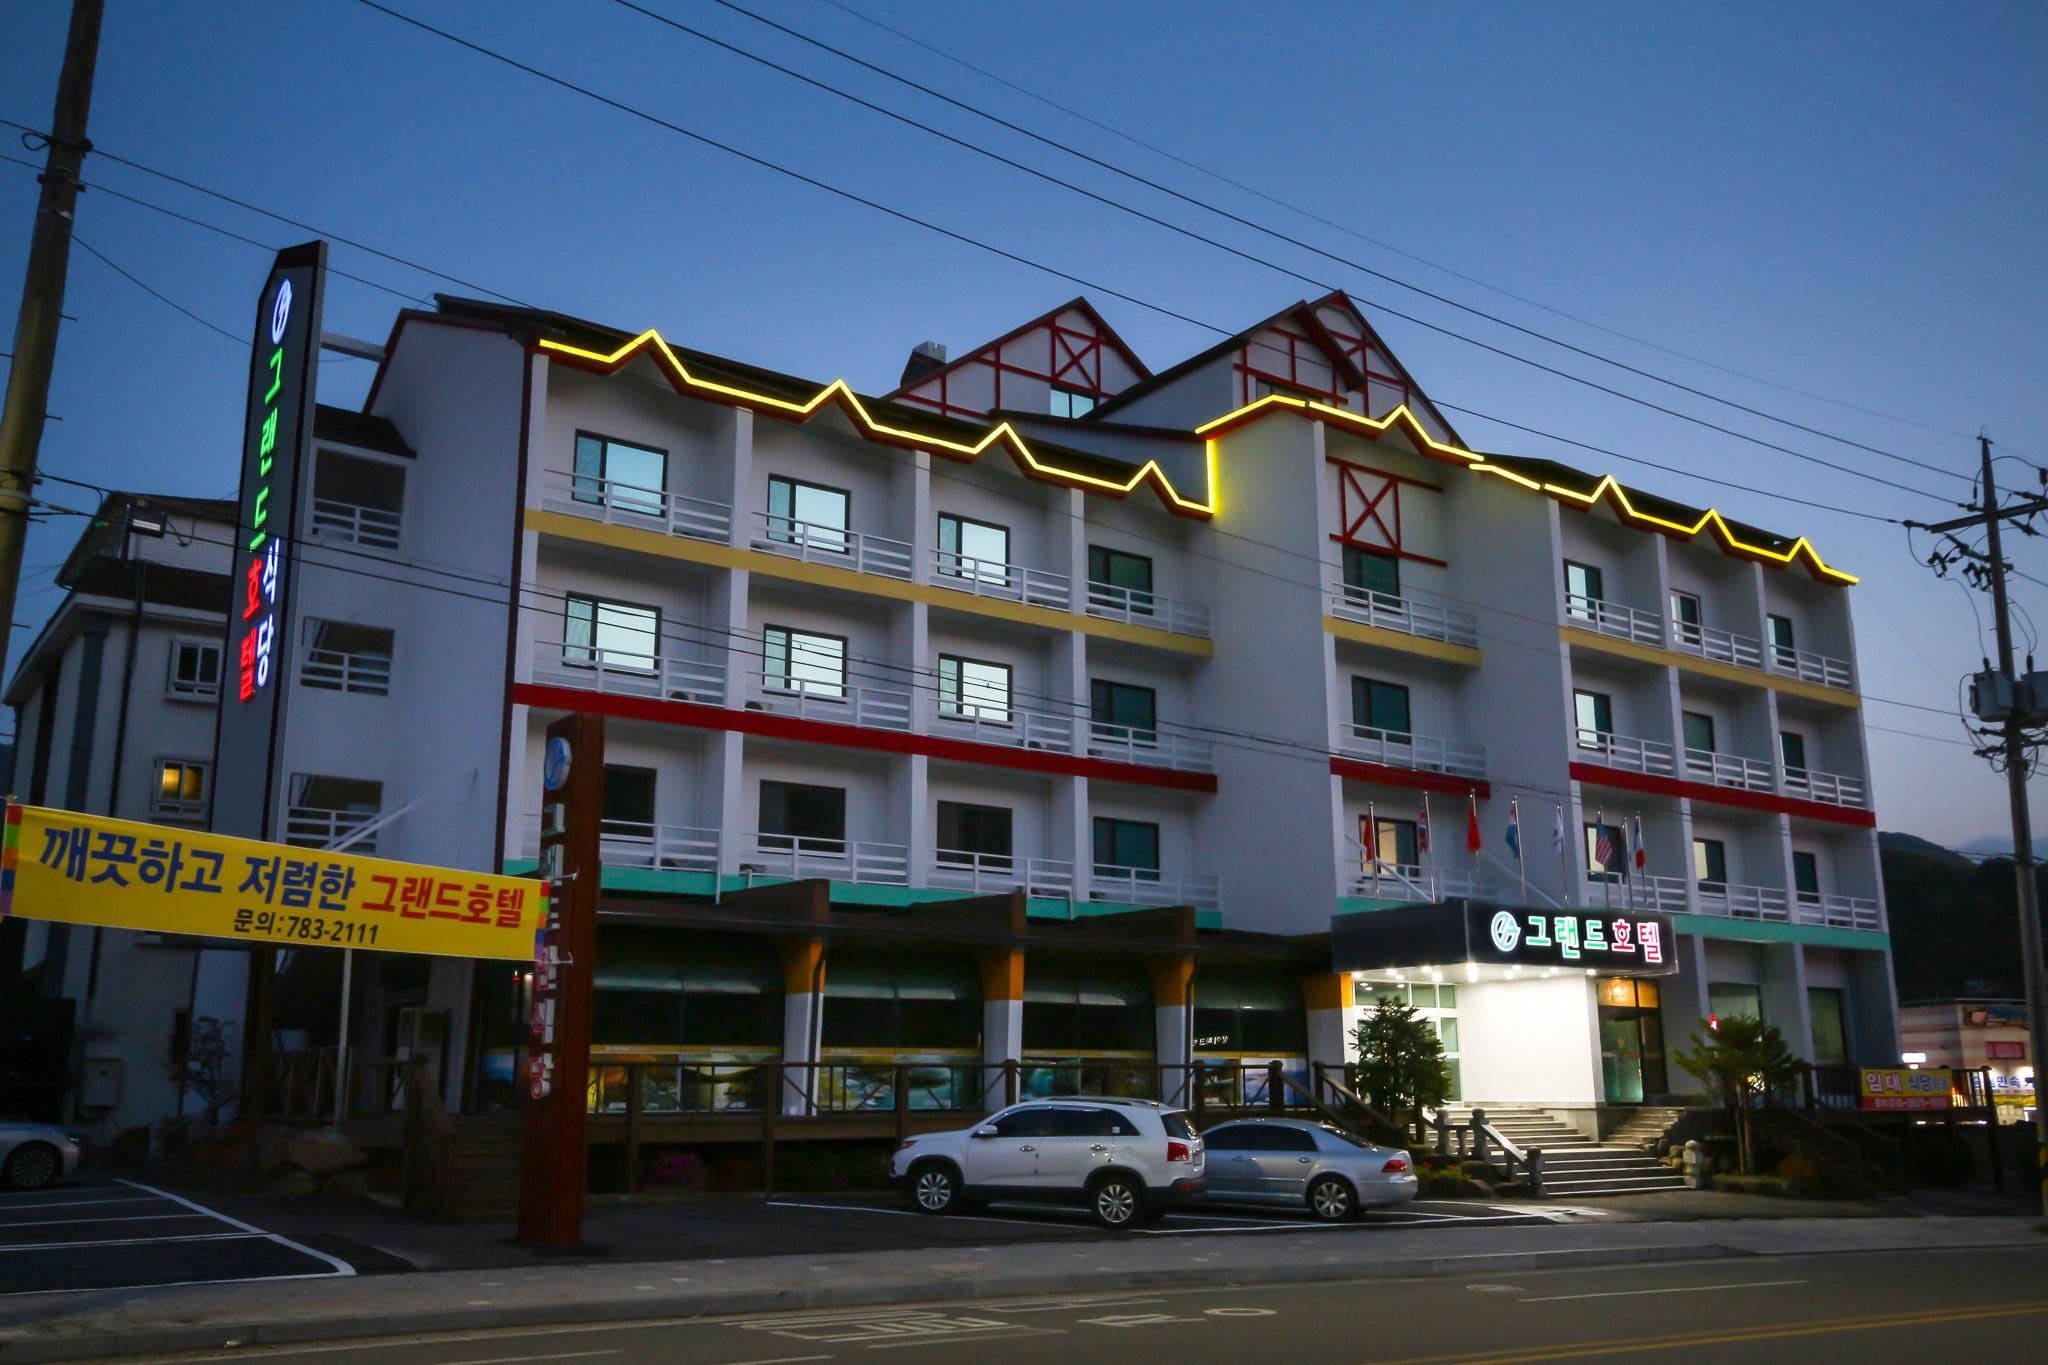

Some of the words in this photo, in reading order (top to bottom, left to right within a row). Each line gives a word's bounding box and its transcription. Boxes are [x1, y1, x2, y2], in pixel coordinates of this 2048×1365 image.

[256, 536, 281, 689] 식당
[39, 827, 225, 893] 깨끗하고
[238, 856, 356, 912] 저렴한
[361, 874, 525, 929] 그랜드호텔
[1525, 915, 1662, 963] 그랜드호텔
